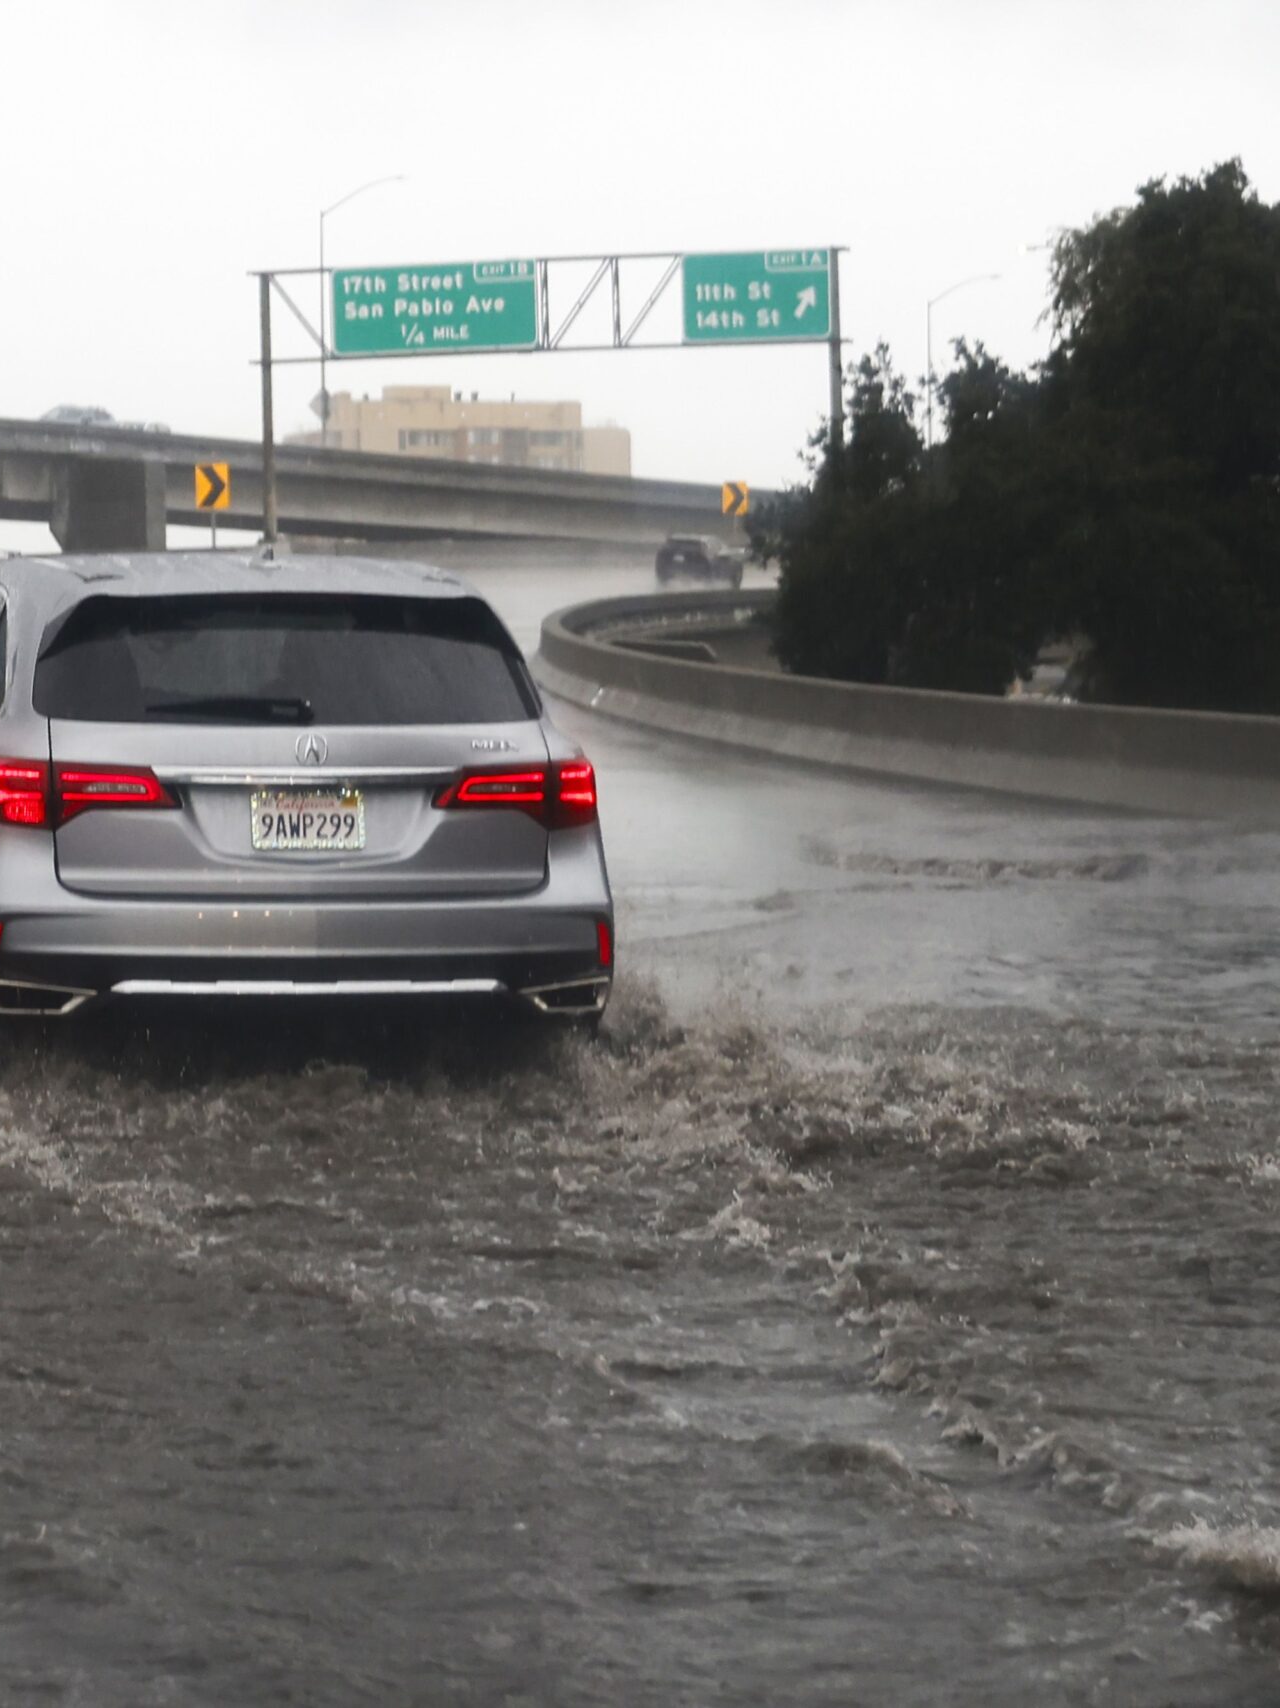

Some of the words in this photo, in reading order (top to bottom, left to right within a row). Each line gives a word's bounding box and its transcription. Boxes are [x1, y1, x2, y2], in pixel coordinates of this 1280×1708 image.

[343, 275, 387, 295] 17th
[397, 271, 464, 292] Street
[695, 283, 737, 302] 11th
[748, 280, 772, 300] St
[344, 301, 384, 320] San
[394, 298, 454, 317] Pablo
[465, 295, 506, 314] Ave
[696, 310, 745, 329] 14th
[756, 308, 781, 328] St
[433, 324, 470, 341] MILE
[261, 813, 356, 839] 9AWP299
